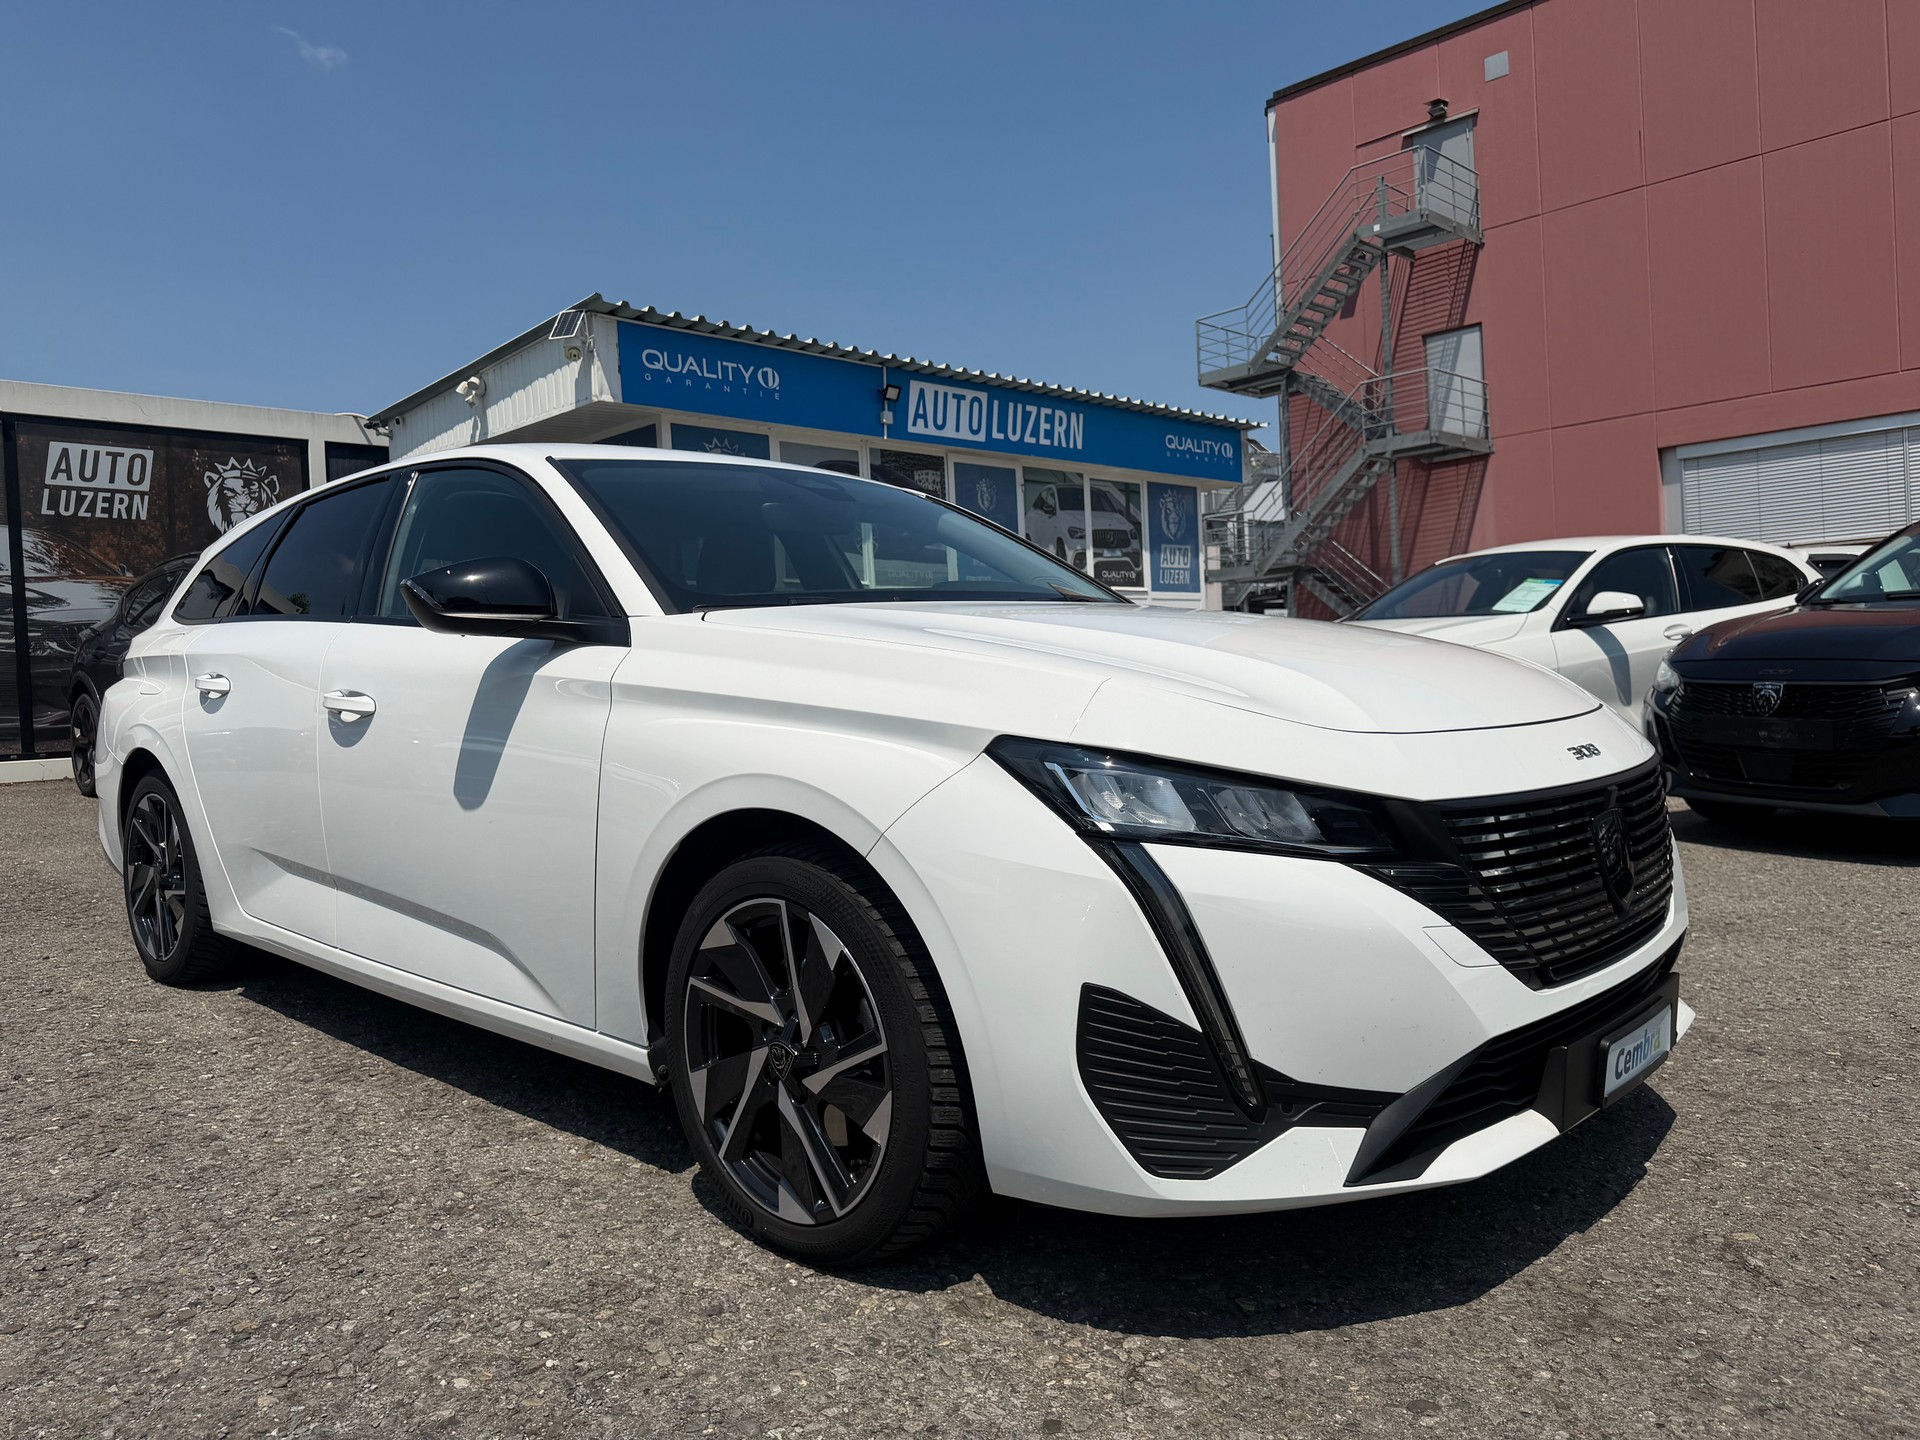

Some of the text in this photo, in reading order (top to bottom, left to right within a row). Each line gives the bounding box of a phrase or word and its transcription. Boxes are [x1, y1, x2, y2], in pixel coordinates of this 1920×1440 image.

[642, 349, 755, 384] QUALITY
[644, 373, 780, 400] GARANTIE
[912, 387, 1084, 450] AUTO LUZERN
[1165, 434, 1220, 455] QUALITY
[50, 447, 148, 486] AUTO
[41, 488, 149, 520] LUZERN
[1162, 546, 1189, 566] AUTO
[1160, 569, 1190, 585] LUZERN
[1566, 743, 1601, 760] 308
[1615, 1028, 1660, 1080] Cembra
